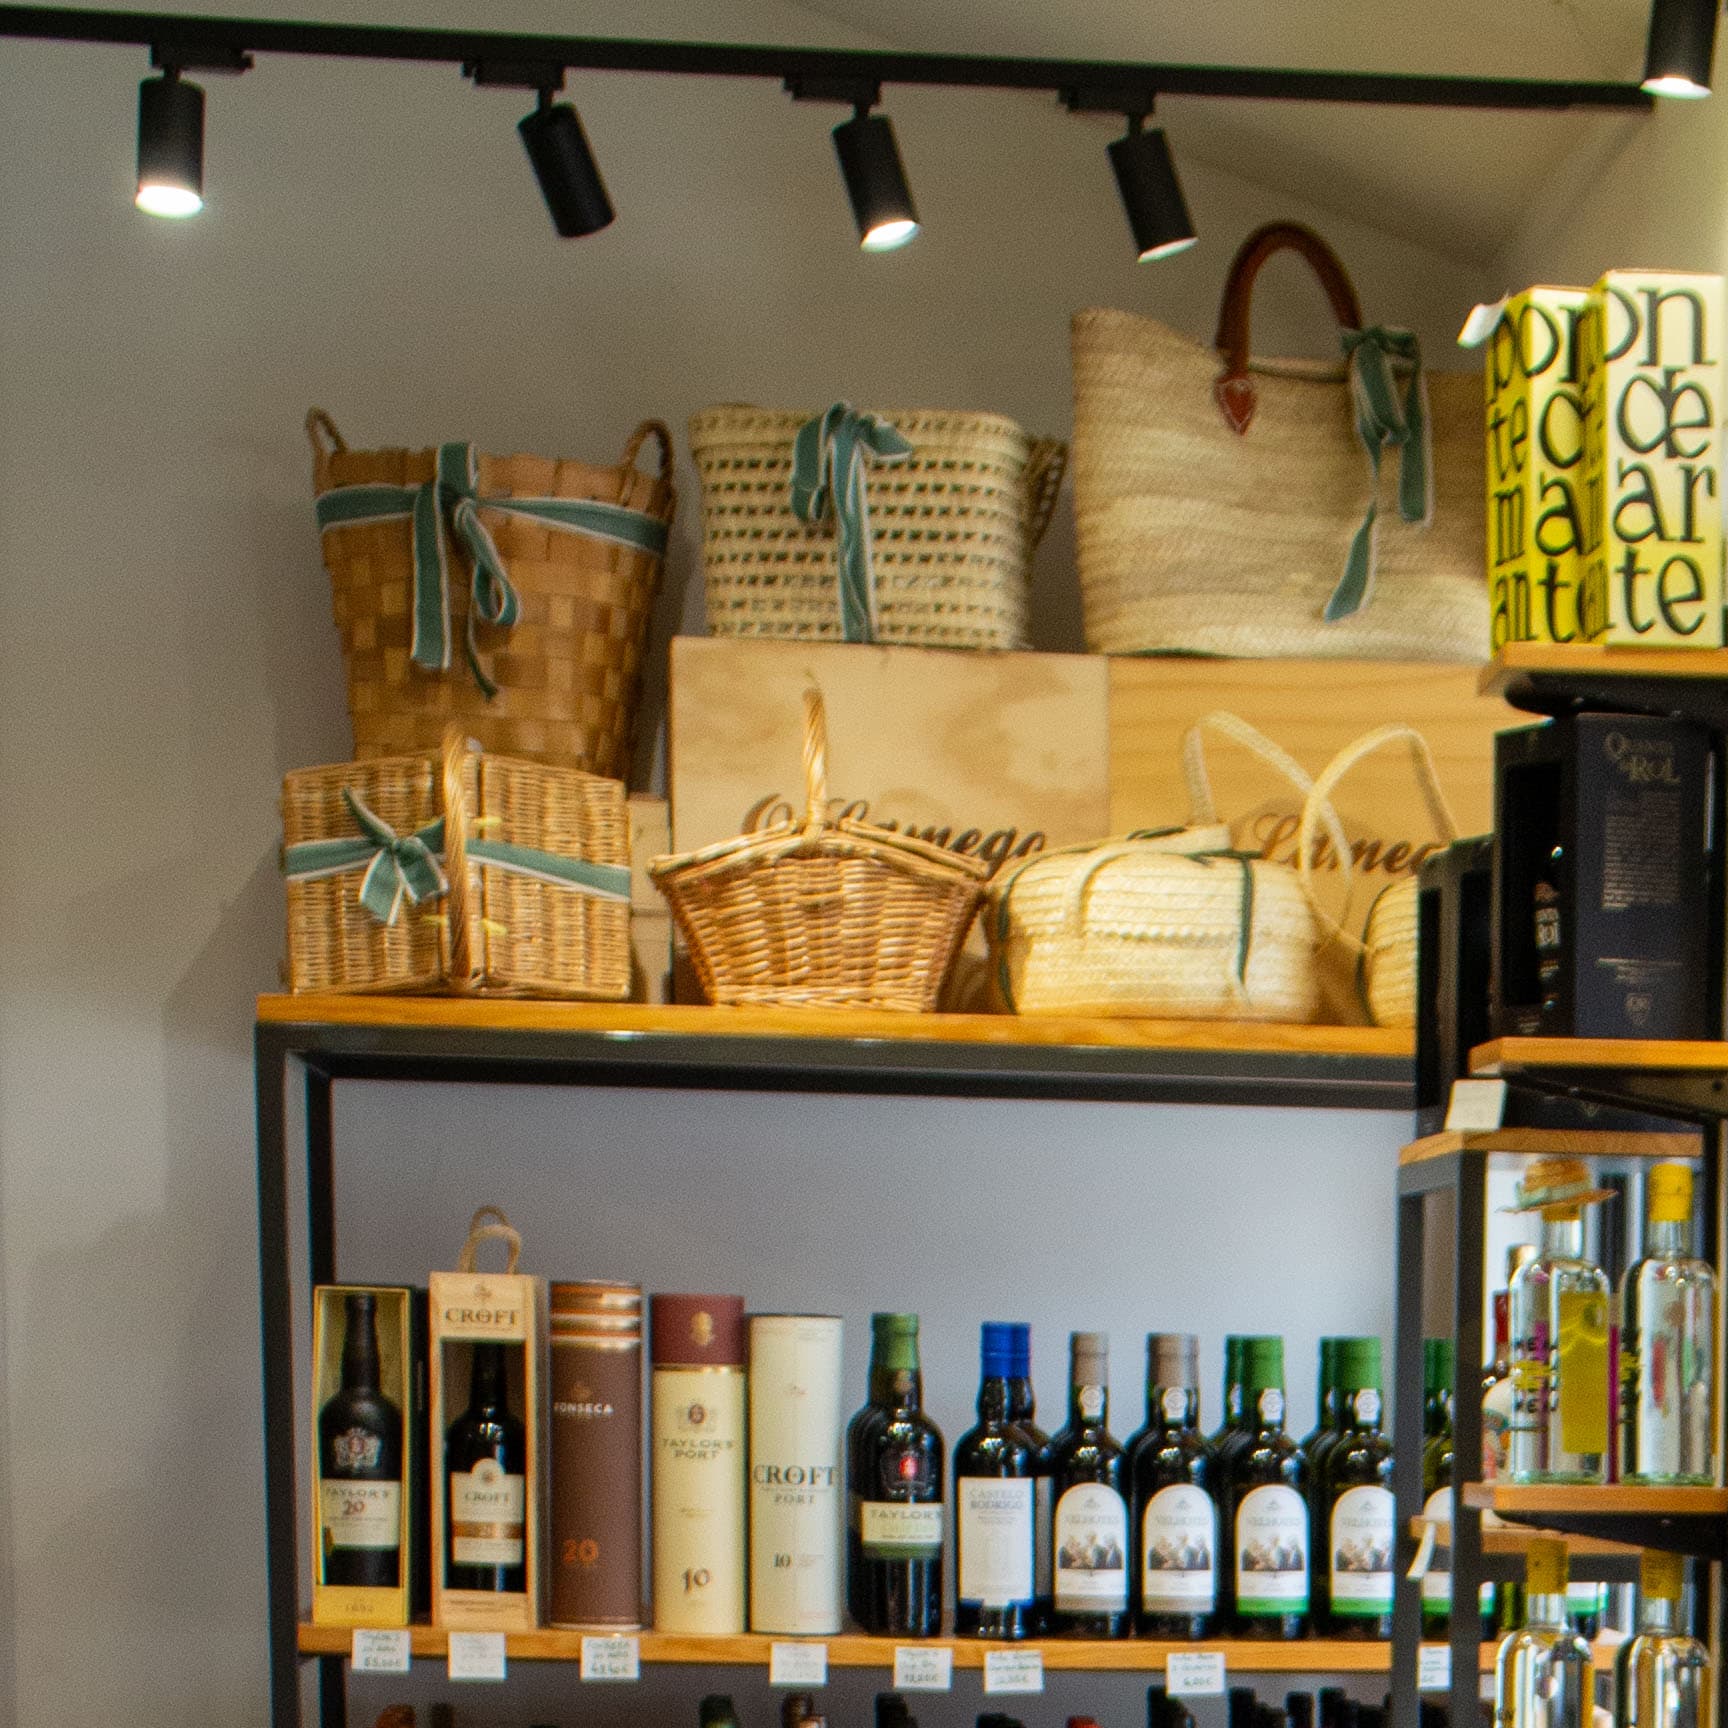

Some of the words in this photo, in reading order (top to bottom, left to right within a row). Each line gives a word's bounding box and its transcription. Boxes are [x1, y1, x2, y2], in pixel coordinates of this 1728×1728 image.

[445, 1307, 519, 1327] CROFT
[674, 1447, 721, 1461] PORT
[753, 1463, 835, 1488] CROFT
[463, 1488, 513, 1506] CROFT
[774, 1494, 816, 1507] PORT
[562, 1539, 599, 1565] 20
[682, 1568, 710, 1592] 10
